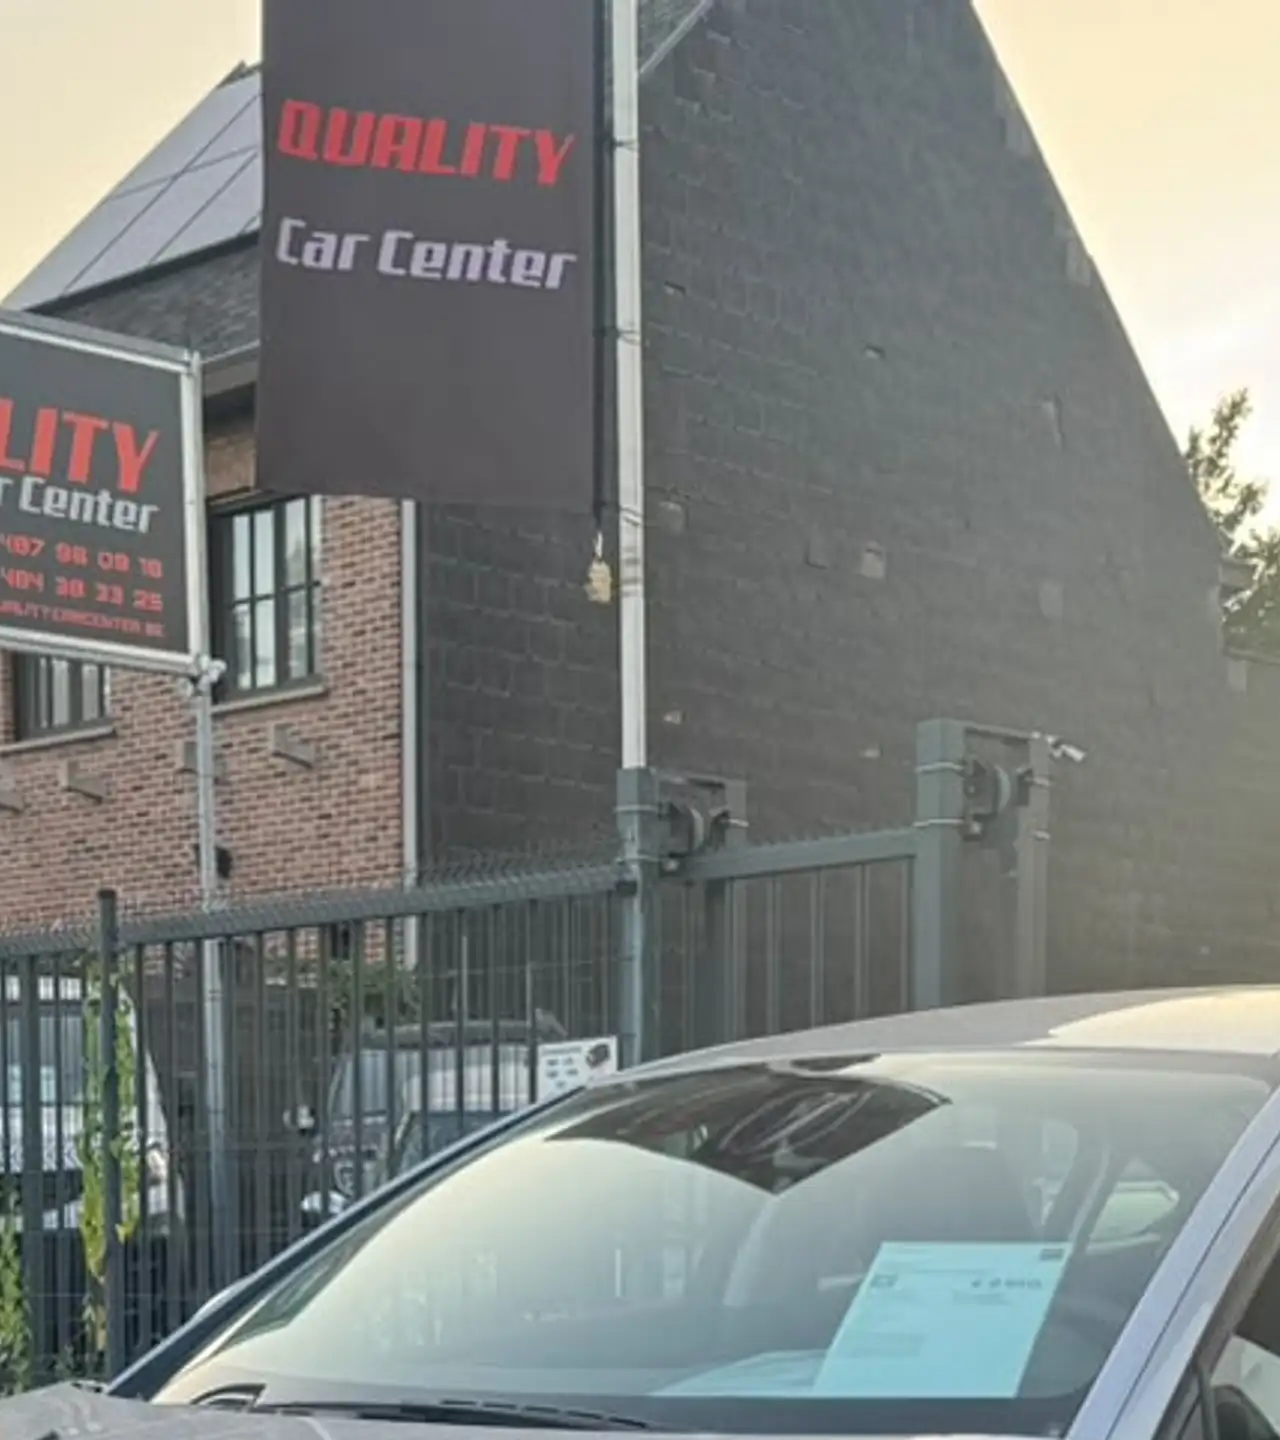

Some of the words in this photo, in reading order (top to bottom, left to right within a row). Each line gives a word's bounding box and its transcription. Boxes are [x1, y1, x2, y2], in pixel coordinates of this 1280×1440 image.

[277, 99, 576, 186] QUALITY
[276, 217, 370, 271] Car
[377, 229, 577, 289] Center
[19, 475, 160, 534] Center
